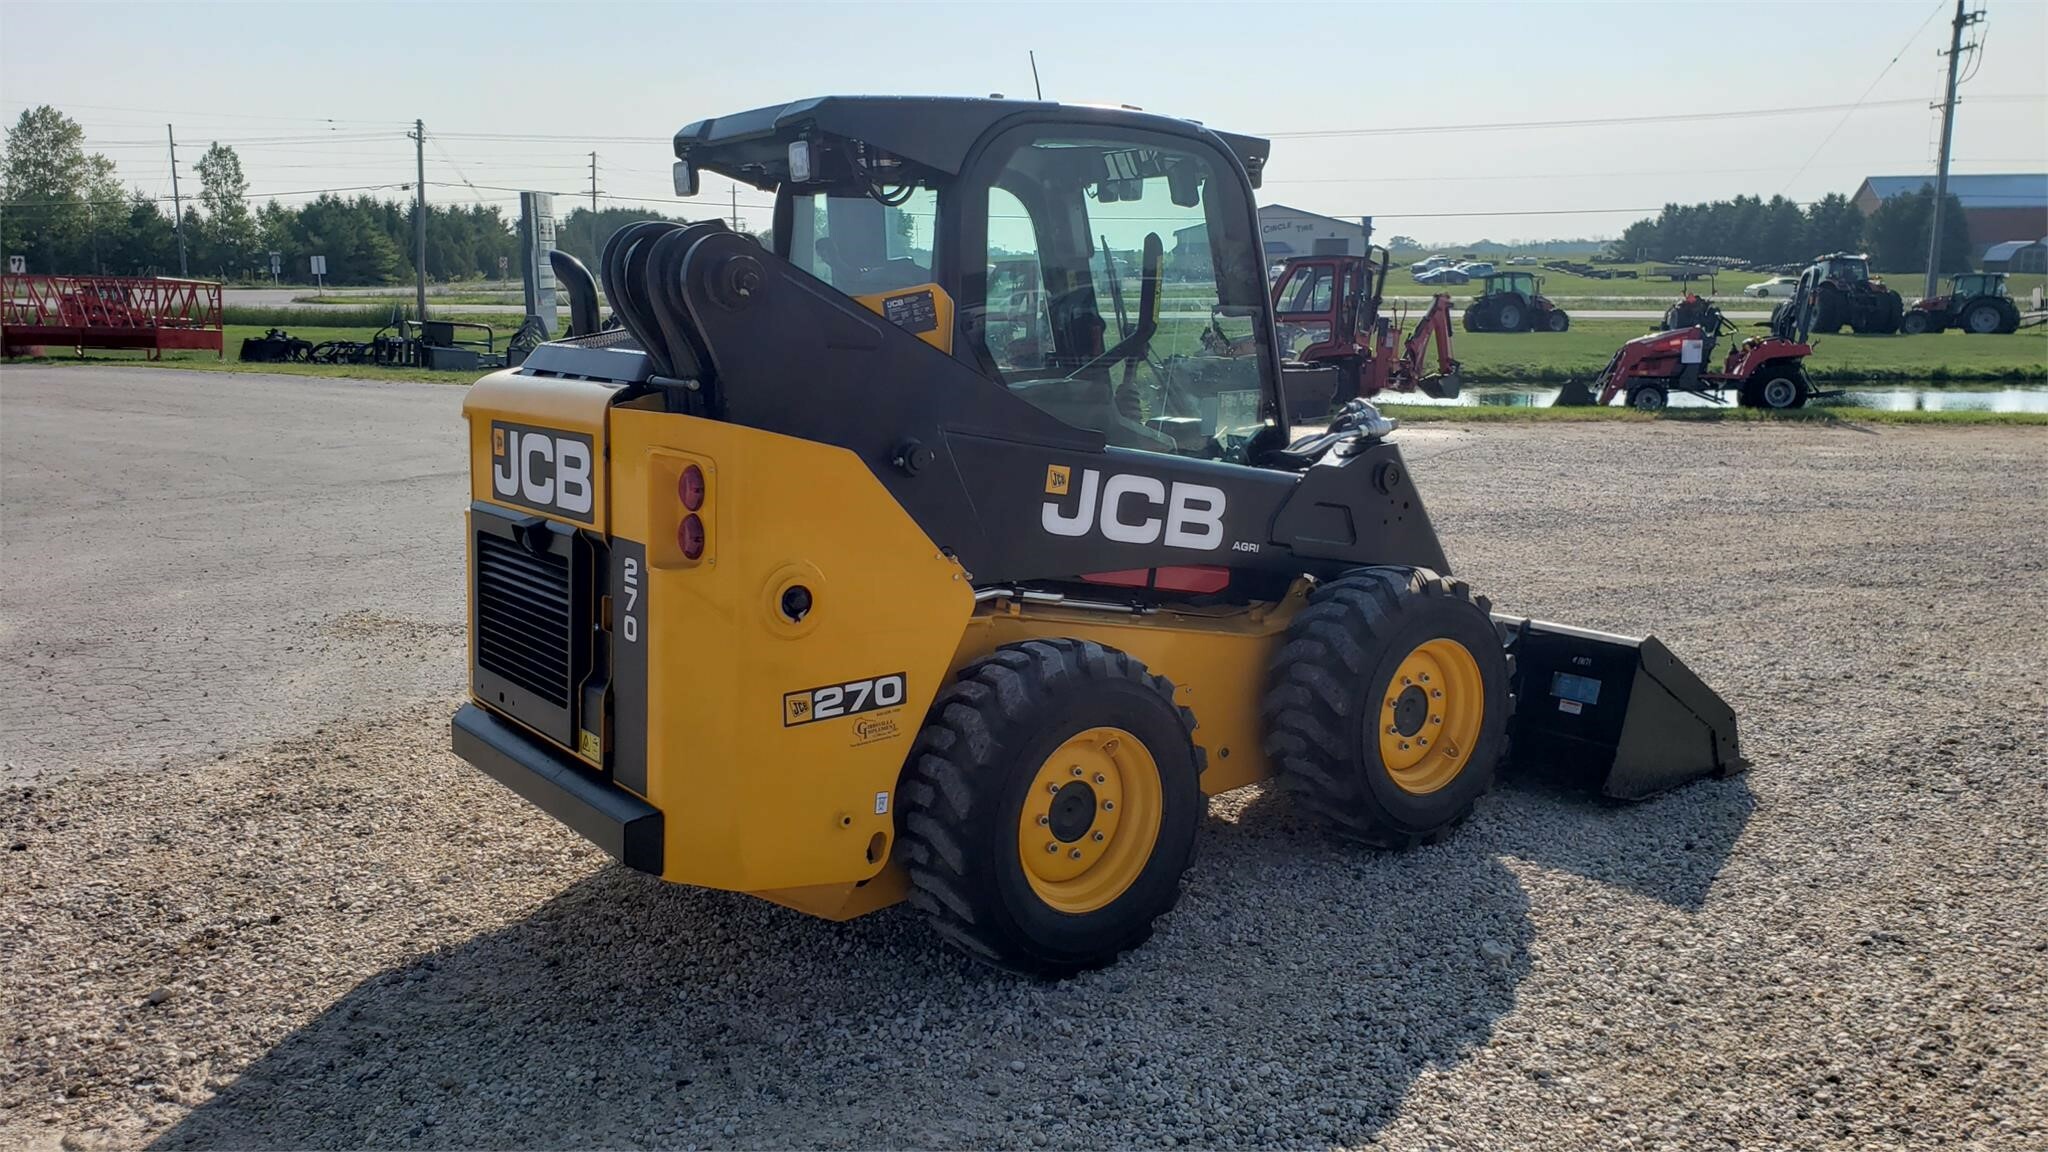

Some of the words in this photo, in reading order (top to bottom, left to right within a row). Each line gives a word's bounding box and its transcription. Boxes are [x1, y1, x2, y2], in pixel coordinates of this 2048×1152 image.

[495, 430, 592, 514] JCB
[1041, 469, 1226, 551] JCB
[1231, 541, 1260, 553] AGRI
[623, 557, 638, 643] 270
[814, 675, 903, 719] 270
